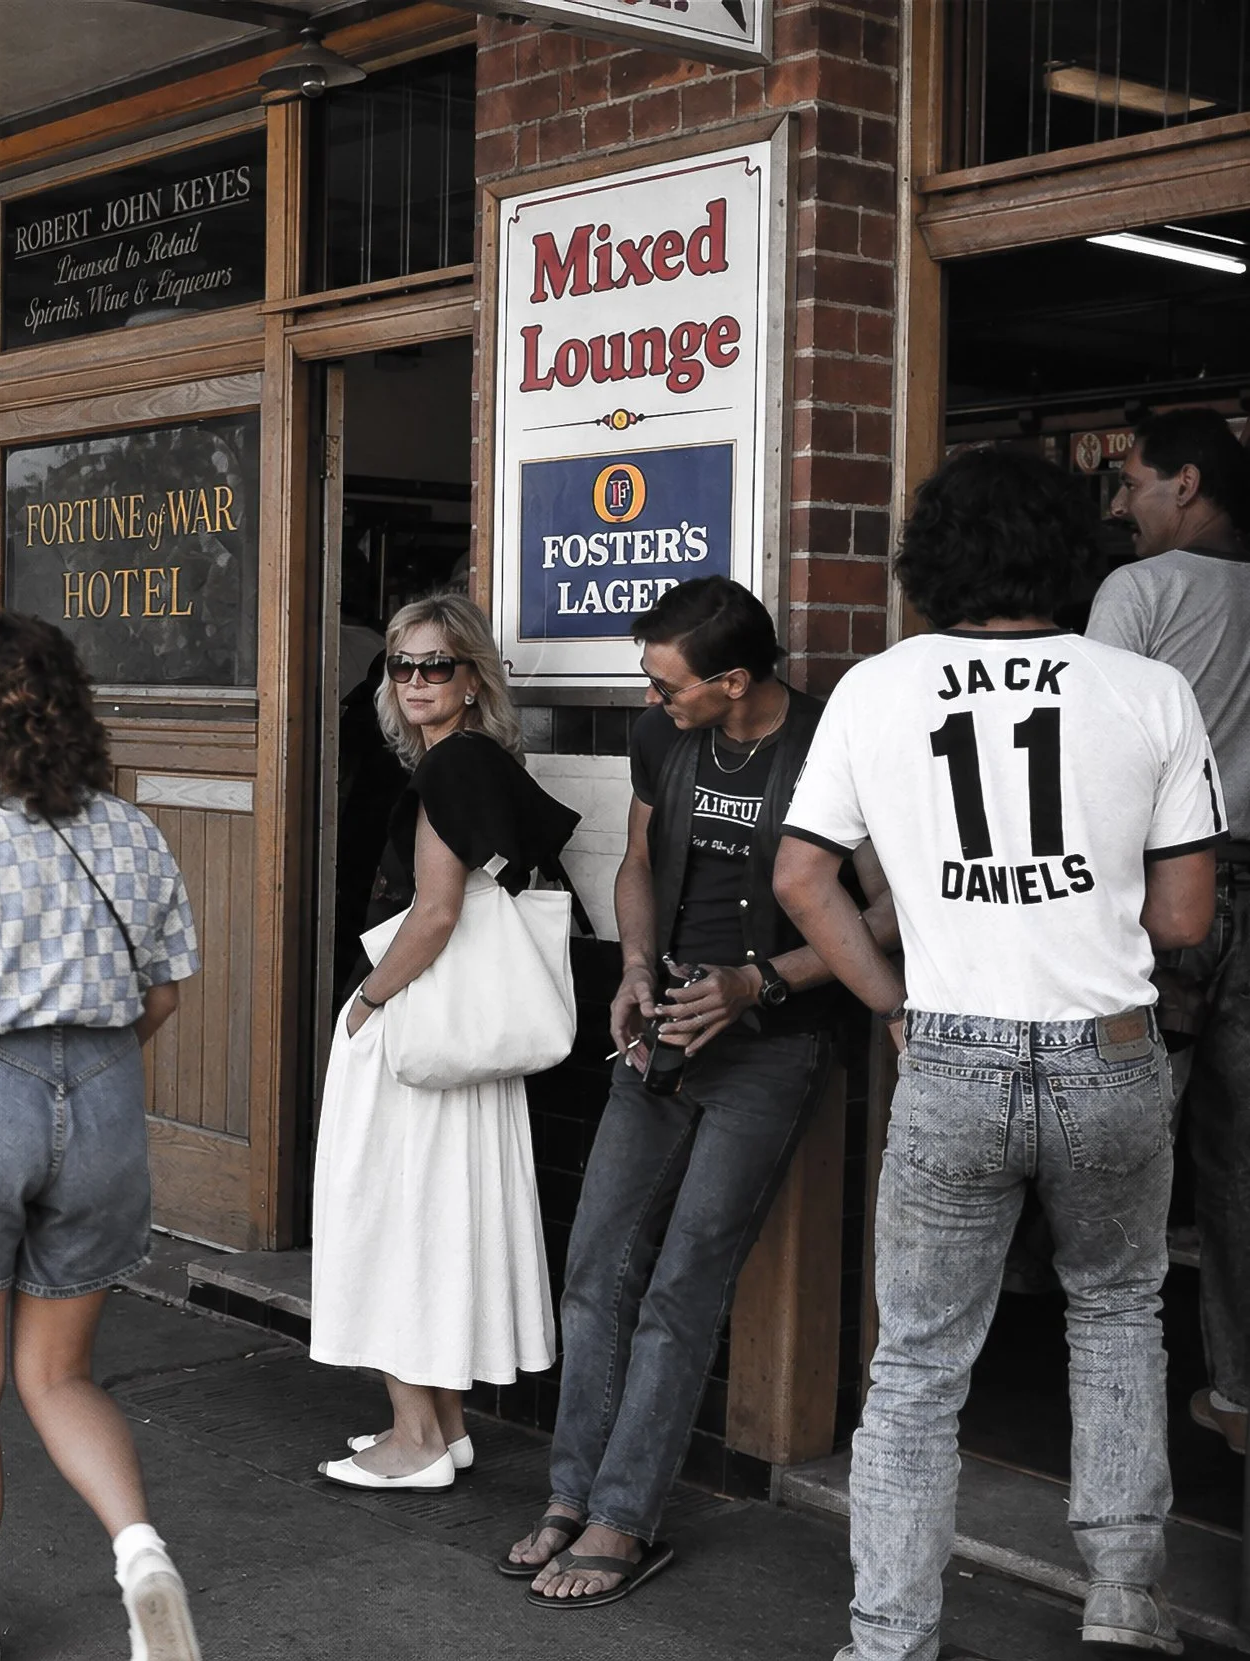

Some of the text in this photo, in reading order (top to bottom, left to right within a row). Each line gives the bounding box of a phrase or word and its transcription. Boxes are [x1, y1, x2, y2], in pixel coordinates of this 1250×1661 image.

[15, 166, 250, 253] ROBERT JOHN KEYES
[54, 242, 123, 286] Licensed
[144, 222, 201, 264] Retail
[530, 197, 729, 304] Mixed
[87, 284, 128, 315] Wine
[153, 267, 232, 305] Liqueurs
[519, 315, 741, 394] Lounge
[25, 485, 237, 551] FORTUNE of WAR
[542, 520, 709, 569] FOSTER'S
[62, 566, 194, 619] HOTEL
[937, 657, 1070, 701] JACK
[929, 706, 1065, 861] 11
[941, 854, 1095, 905] DANIELS
